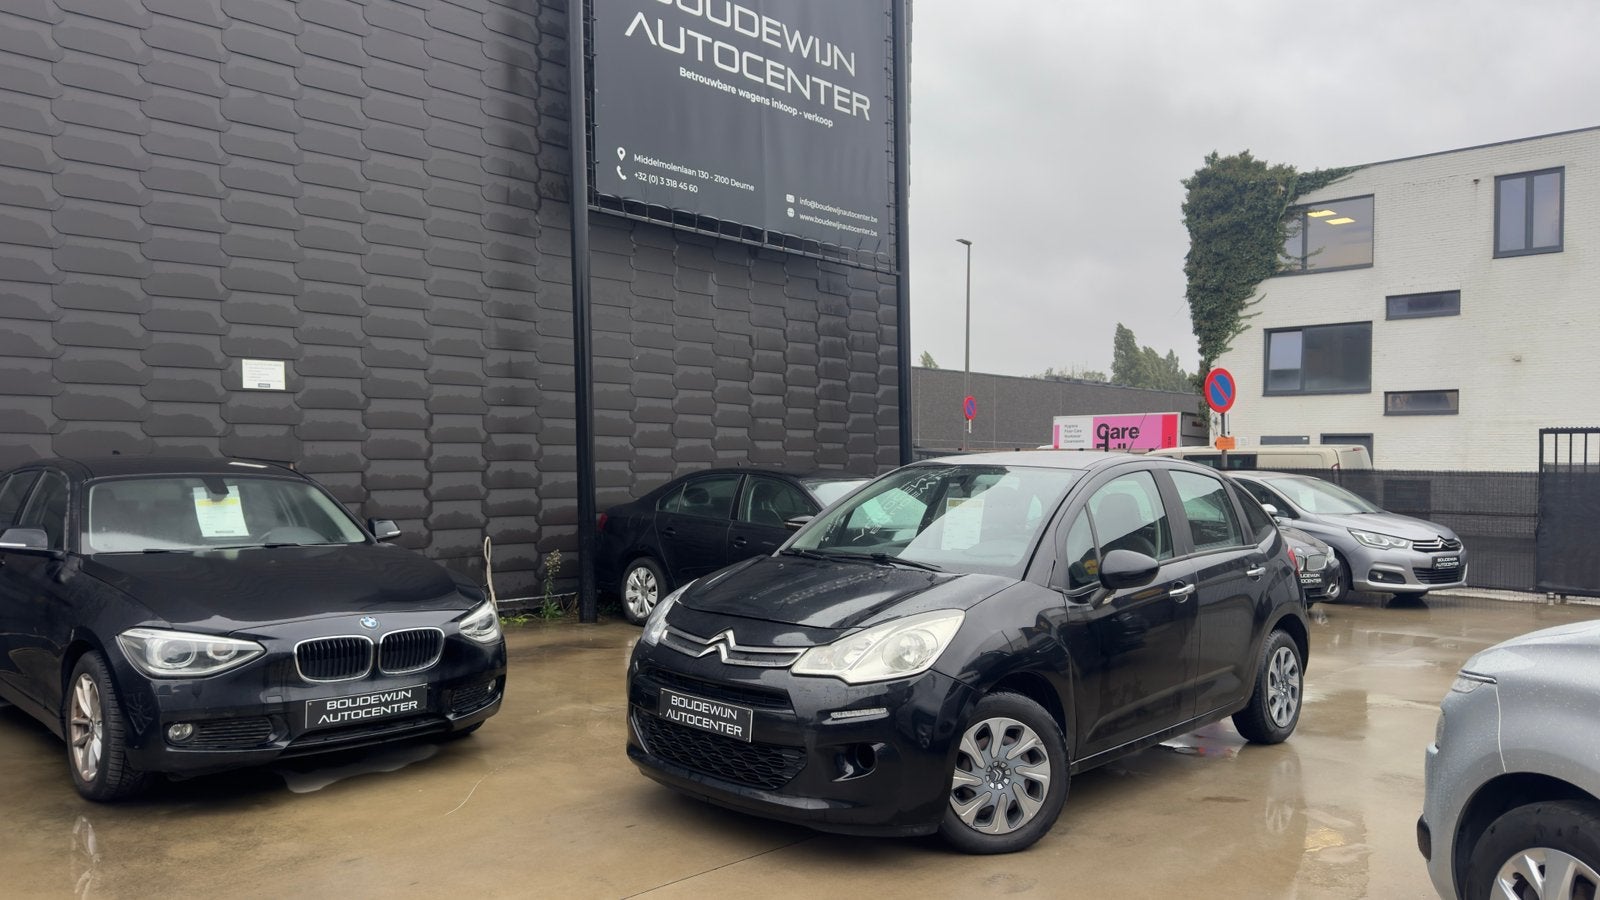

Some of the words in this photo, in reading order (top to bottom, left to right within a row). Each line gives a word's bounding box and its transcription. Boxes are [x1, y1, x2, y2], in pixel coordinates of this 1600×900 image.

[656, 0, 855, 77] UDEWIJN
[624, 11, 871, 121] AUTOCENTER
[679, 66, 737, 94] Betrouwbare
[738, 88, 771, 107] wagens
[771, 97, 798, 117] inkoop
[803, 110, 834, 128] verkoop
[633, 153, 697, 177] Middelmolenlaan
[698, 169, 710, 180] 130
[714, 174, 730, 186] 2100
[730, 178, 755, 192] Deurne
[634, 171, 648, 182] +32
[648, 175, 659, 186] (0)
[659, 177, 665, 185] 3
[665, 179, 678, 188] 318
[678, 181, 688, 191] 45
[688, 184, 699, 193] 60
[799, 197, 878, 223] info@boudewijnautocenter.be
[799, 213, 878, 237] www.boudewijnautocenter.be
[318, 700, 418, 724] AUTOCENTER
[326, 689, 412, 710] BOUDEWIJN
[671, 695, 738, 720] BOUDEWIJN
[665, 709, 743, 737] AUTOCENTER
